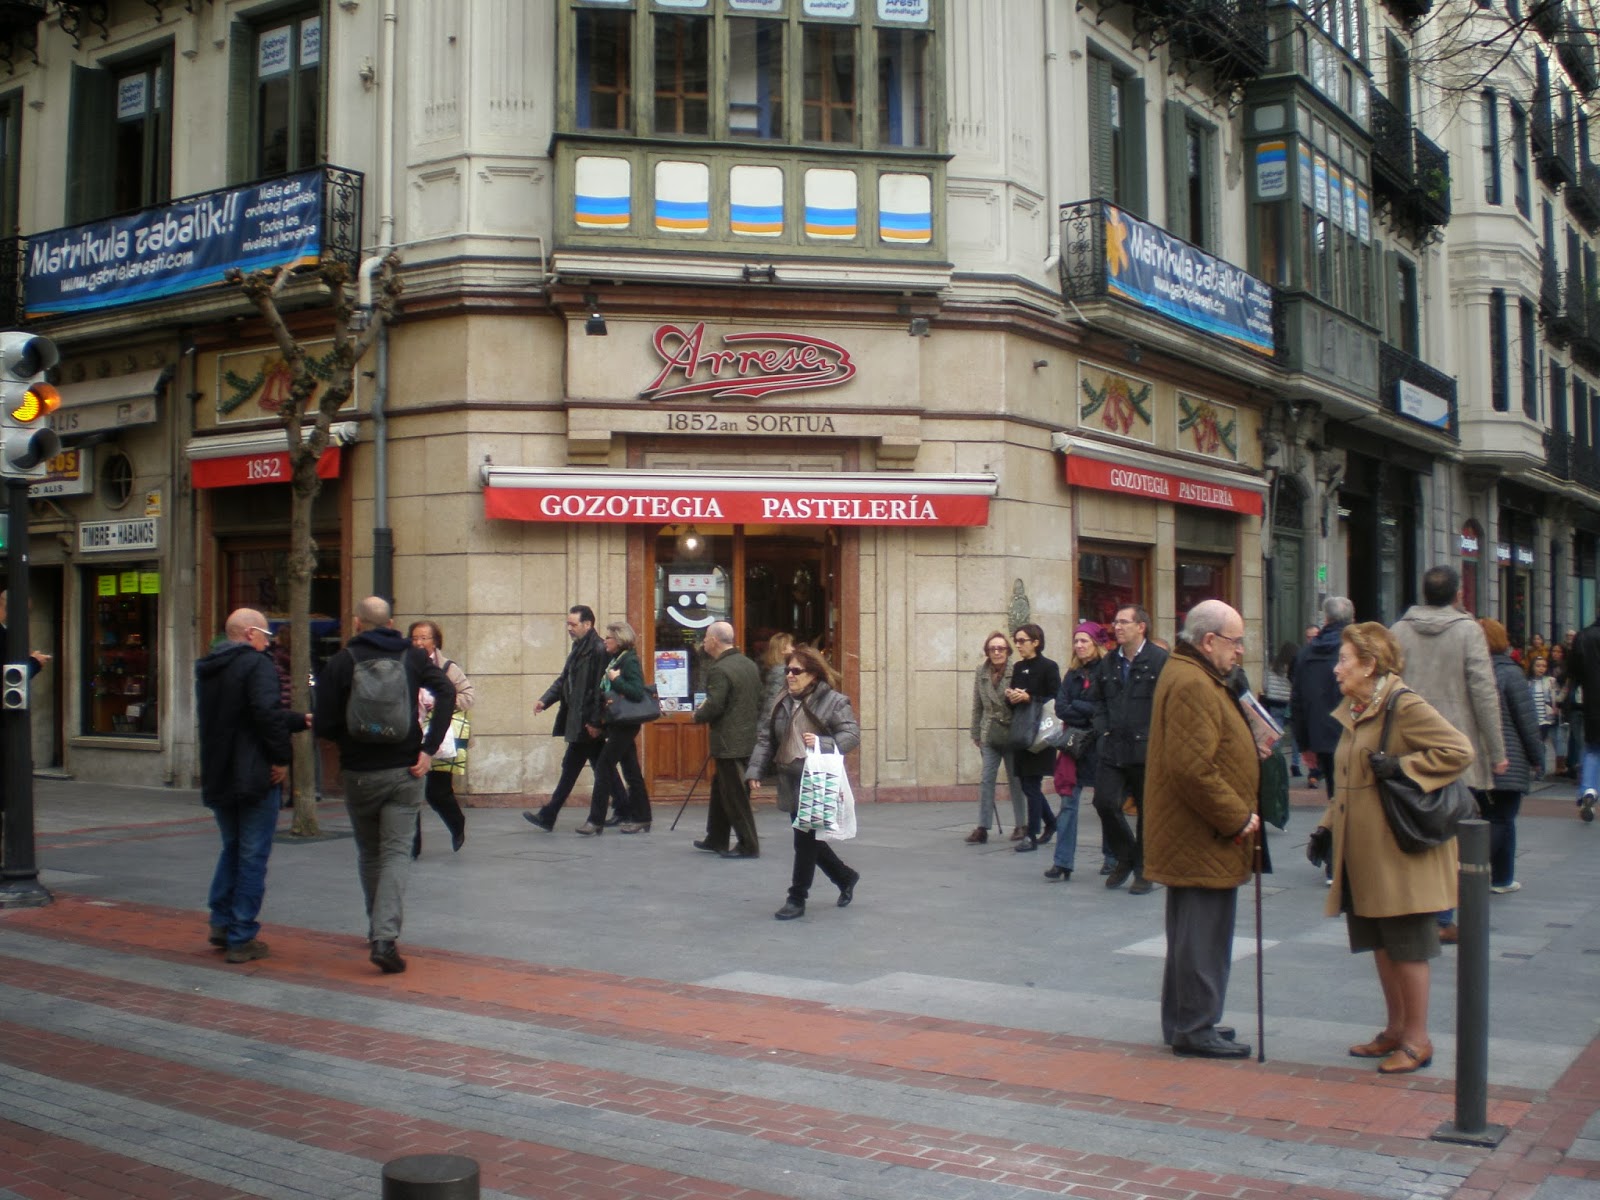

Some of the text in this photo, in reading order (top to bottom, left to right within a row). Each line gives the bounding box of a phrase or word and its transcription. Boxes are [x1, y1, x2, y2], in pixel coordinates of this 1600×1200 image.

[30, 192, 239, 277] Matrikula zabalik!!
[259, 215, 299, 234] Todos los
[1131, 224, 1193, 282] Matrikula
[60, 250, 194, 292] www.gabrielaresti.com
[666, 413, 836, 433] 1852an SORTUA
[246, 458, 281, 479] 1852
[1110, 468, 1234, 507] GOZOTEGIA PASTELERÍA
[539, 494, 938, 520] GOZOTEGIA PASTELERÍA
[82, 526, 109, 547] TIMBRE
[117, 523, 154, 544] HABANOS
